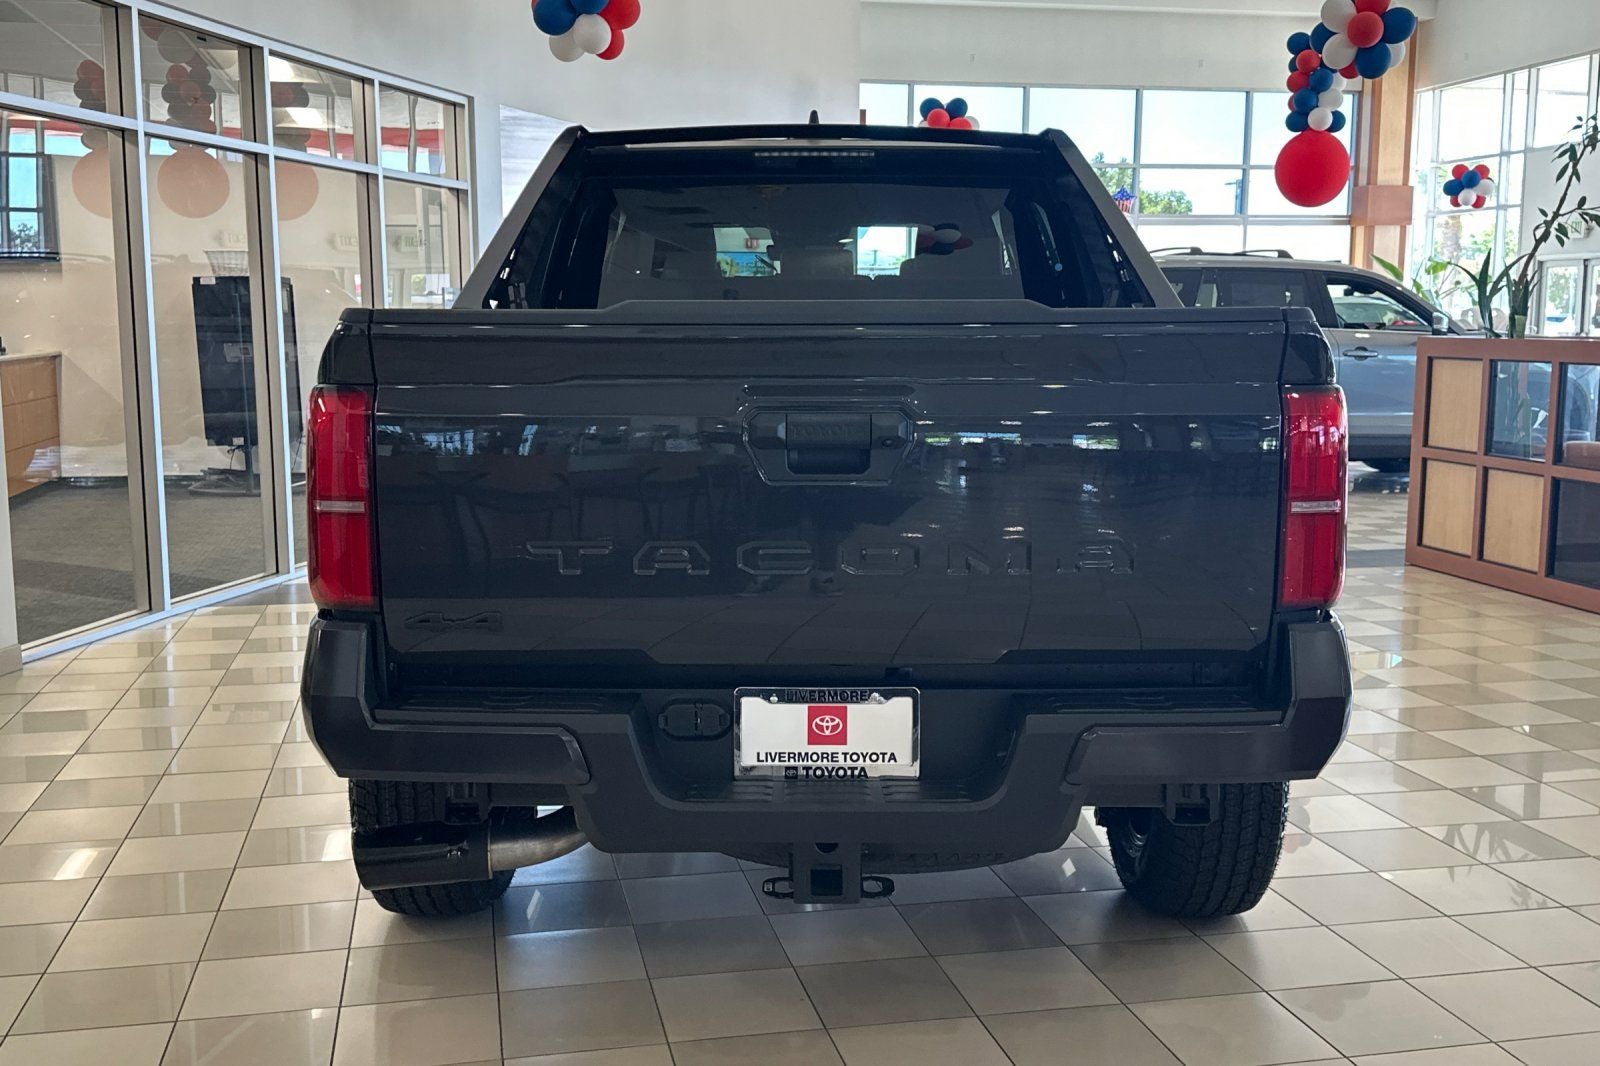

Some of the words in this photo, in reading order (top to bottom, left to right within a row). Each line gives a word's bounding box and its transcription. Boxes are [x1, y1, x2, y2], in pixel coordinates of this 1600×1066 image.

[524, 540, 1135, 576] TACOMA
[785, 690, 869, 703] LIVERMORE
[756, 752, 839, 763] LIVERMORE
[842, 752, 898, 763] TOYOTA
[803, 766, 870, 779] TOYOTA
